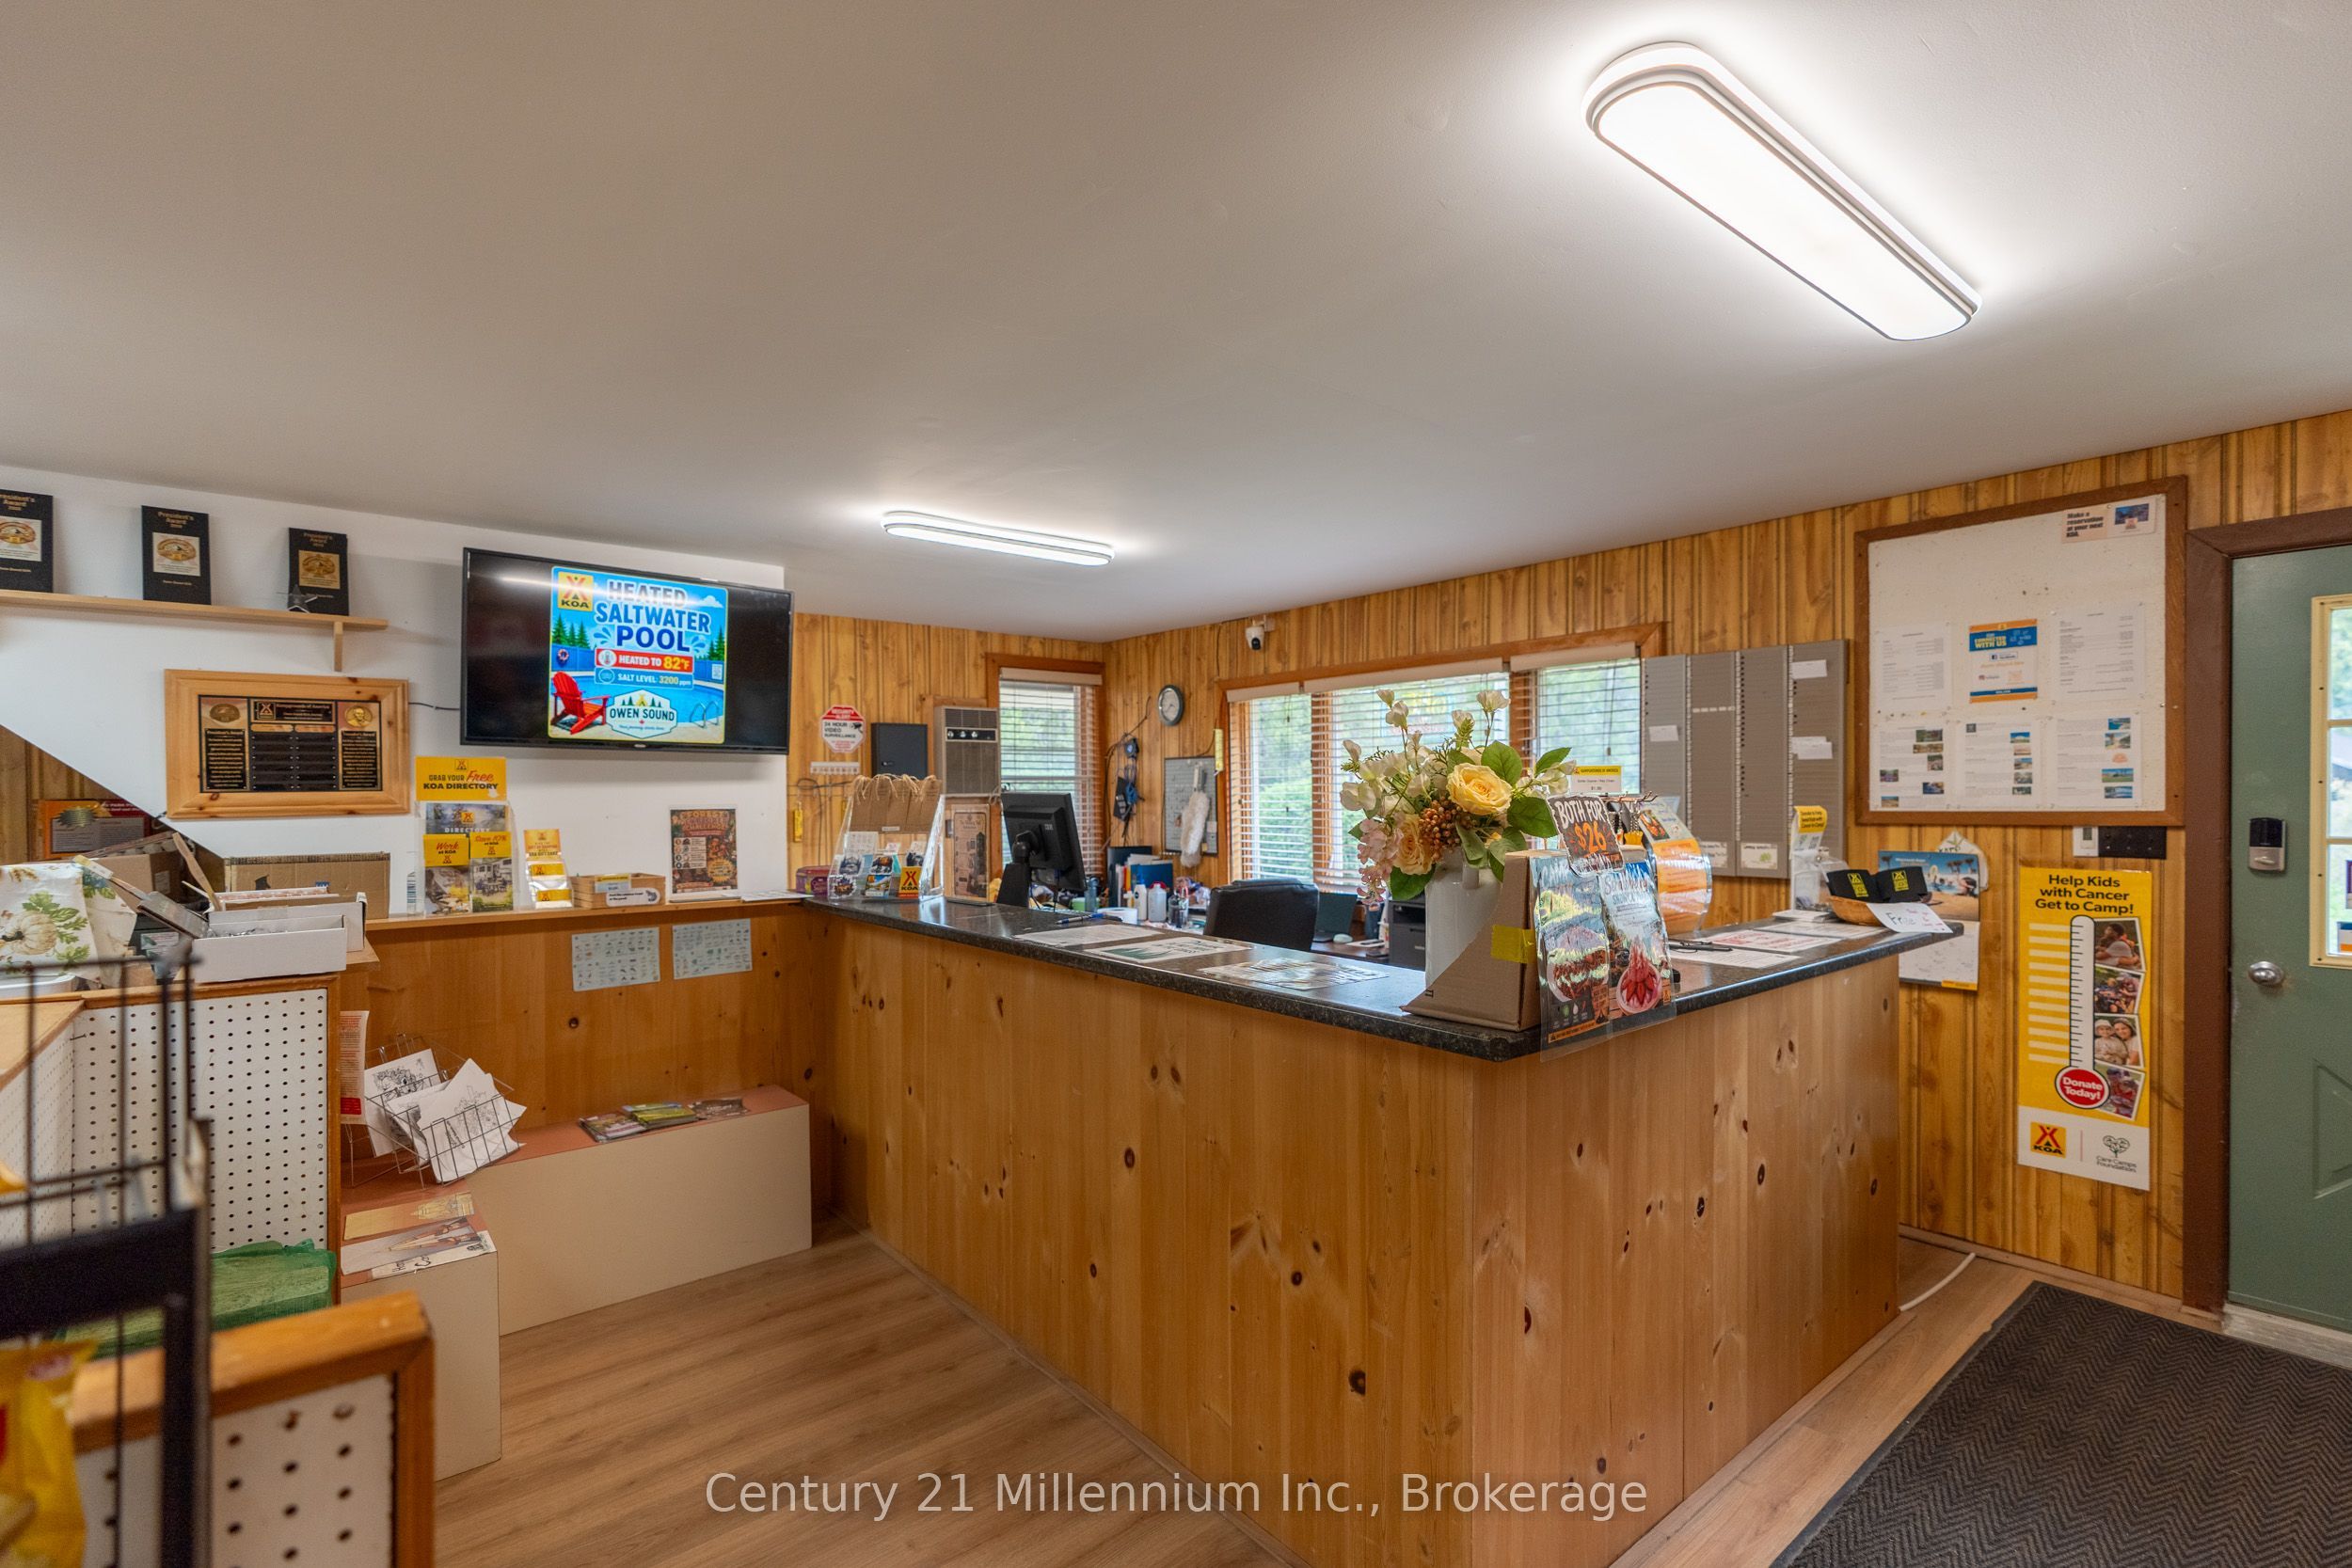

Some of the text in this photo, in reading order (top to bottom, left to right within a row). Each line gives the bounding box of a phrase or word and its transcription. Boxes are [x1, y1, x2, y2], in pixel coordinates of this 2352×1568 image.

[609, 580, 687, 608] HEATED
[561, 599, 590, 610] KOA
[596, 602, 710, 634] SALTWATER
[616, 626, 691, 653] POOL
[618, 654, 650, 666] HEATED
[651, 657, 662, 667] TO
[617, 673, 635, 682] SALT
[610, 707, 675, 721] OWEN SOUND
[466, 769, 495, 783] Free
[1554, 799, 1607, 830] BOTH FOR
[1574, 819, 1607, 854] $26
[437, 841, 460, 850] Work
[2048, 874, 2121, 888] Help Kids
[2040, 887, 2130, 901] with Cancer
[2035, 898, 2134, 916] Get to Camp!
[2062, 1076, 2104, 1091] Donate
[2064, 1085, 2102, 1101] Today!
[2033, 1145, 2063, 1155] KOA
[2112, 1159, 2137, 1168] Camps
